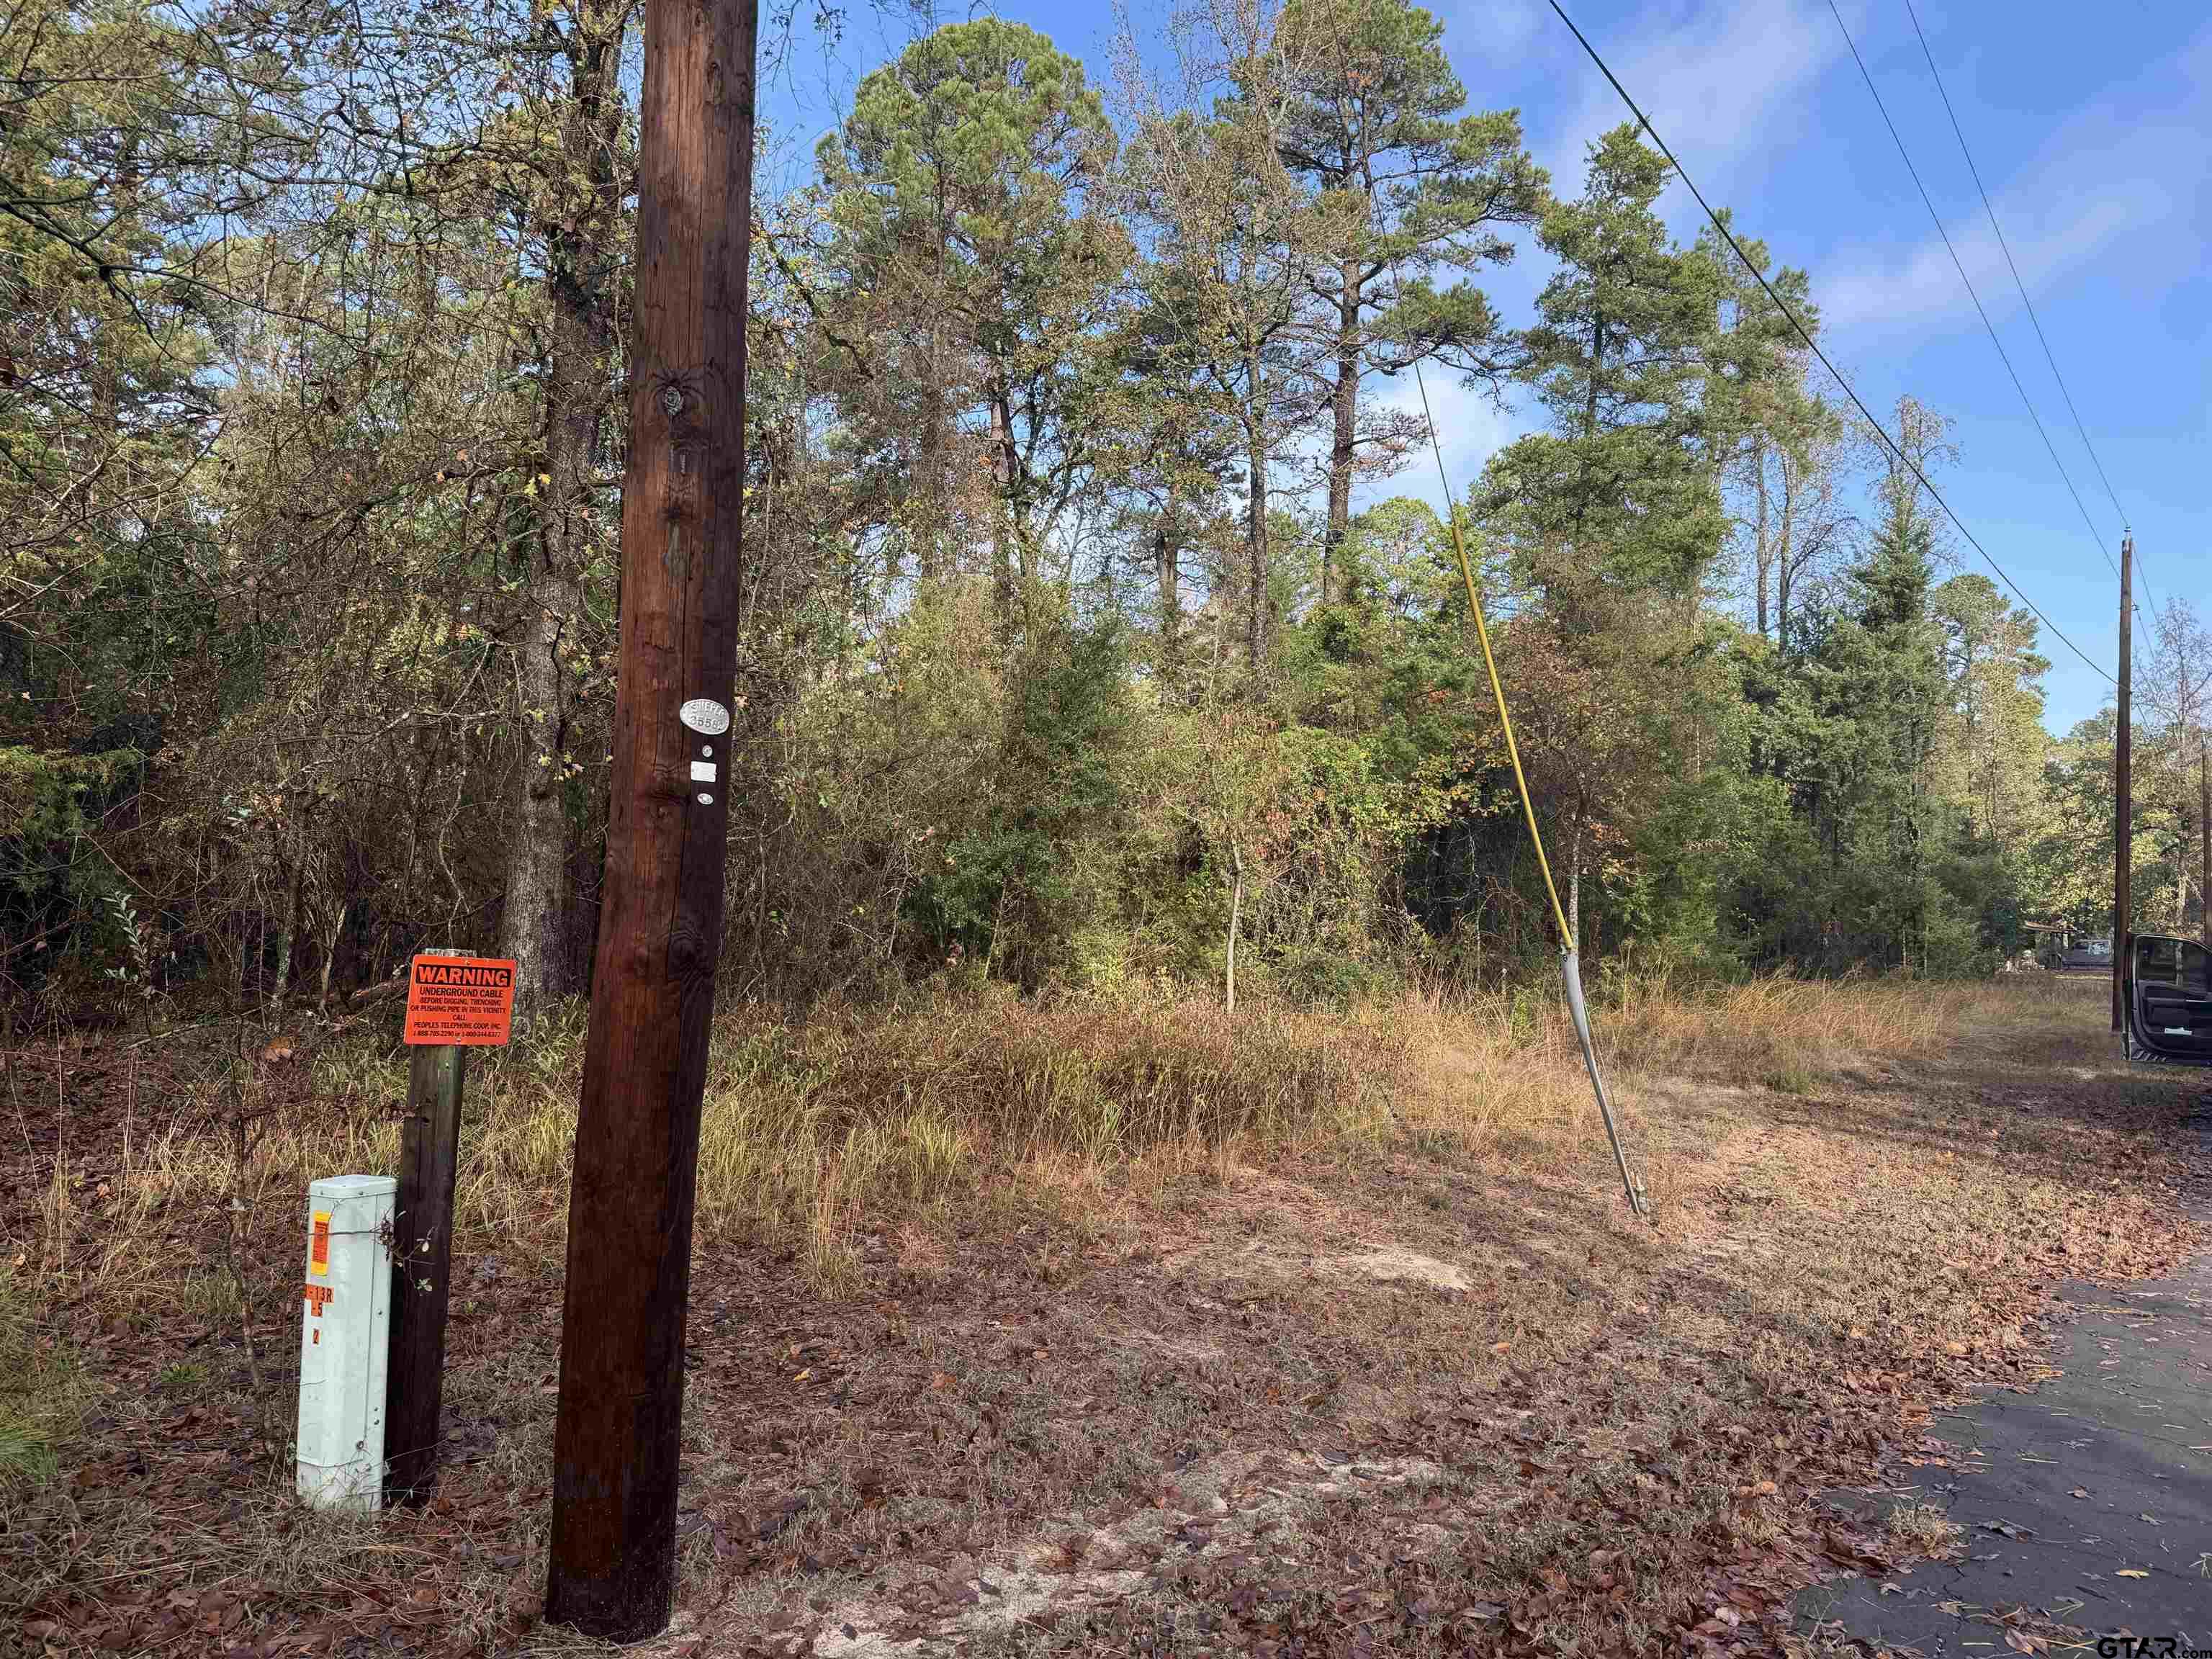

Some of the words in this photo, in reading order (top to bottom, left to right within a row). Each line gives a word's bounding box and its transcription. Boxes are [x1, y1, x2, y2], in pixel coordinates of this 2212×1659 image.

[418, 966, 508, 986] WARNING
[420, 986, 478, 998] UNDERGROUND
[480, 989, 504, 998] CABLE
